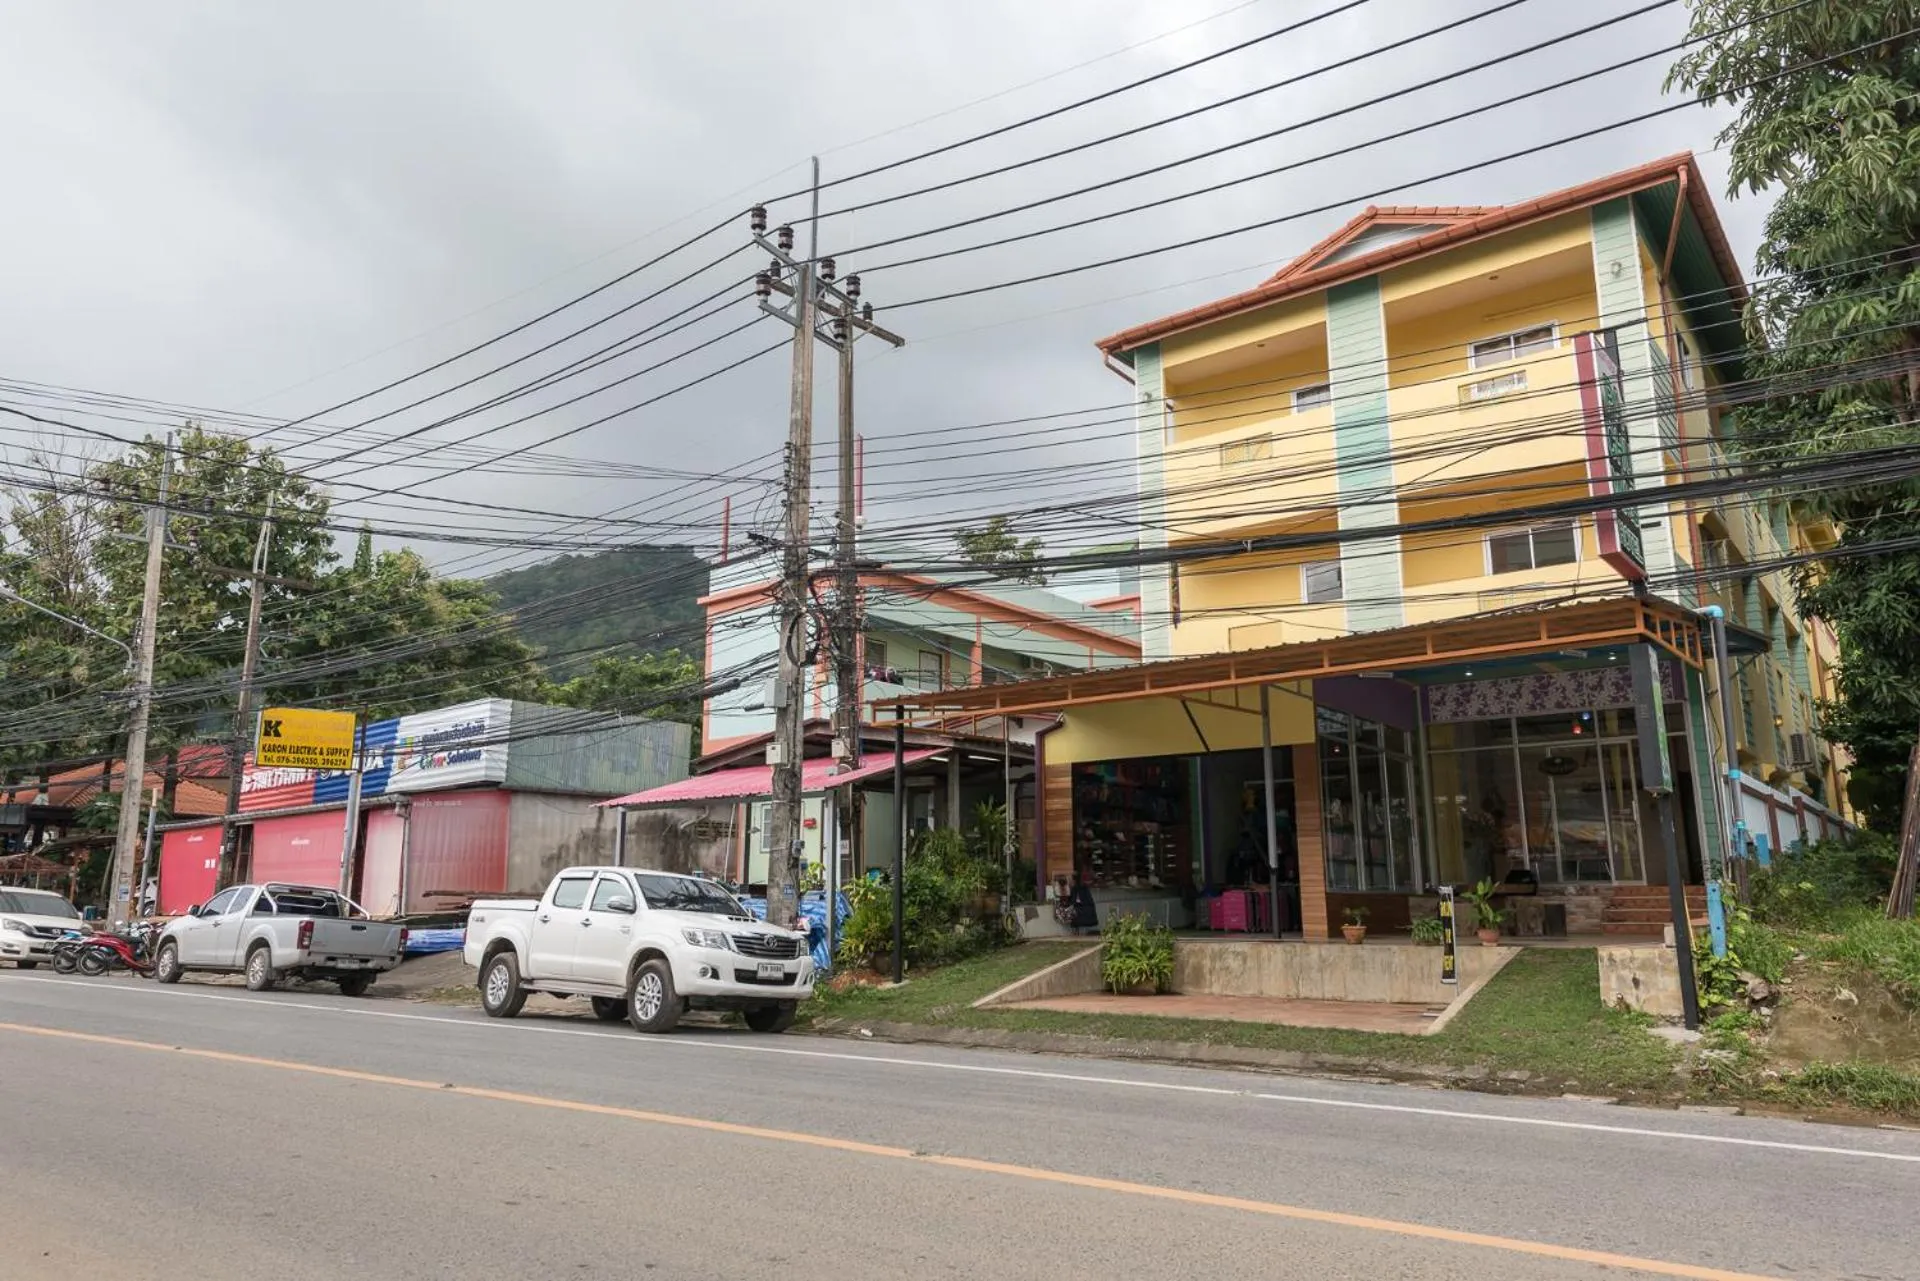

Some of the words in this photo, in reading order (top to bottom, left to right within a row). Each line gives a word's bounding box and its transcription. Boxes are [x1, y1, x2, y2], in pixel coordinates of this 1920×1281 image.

[264, 720, 282, 737] K
[262, 743, 287, 753] KARON
[288, 744, 317, 755] ELECTRIC
[319, 747, 324, 756] &
[326, 747, 350, 757] SUPPLY
